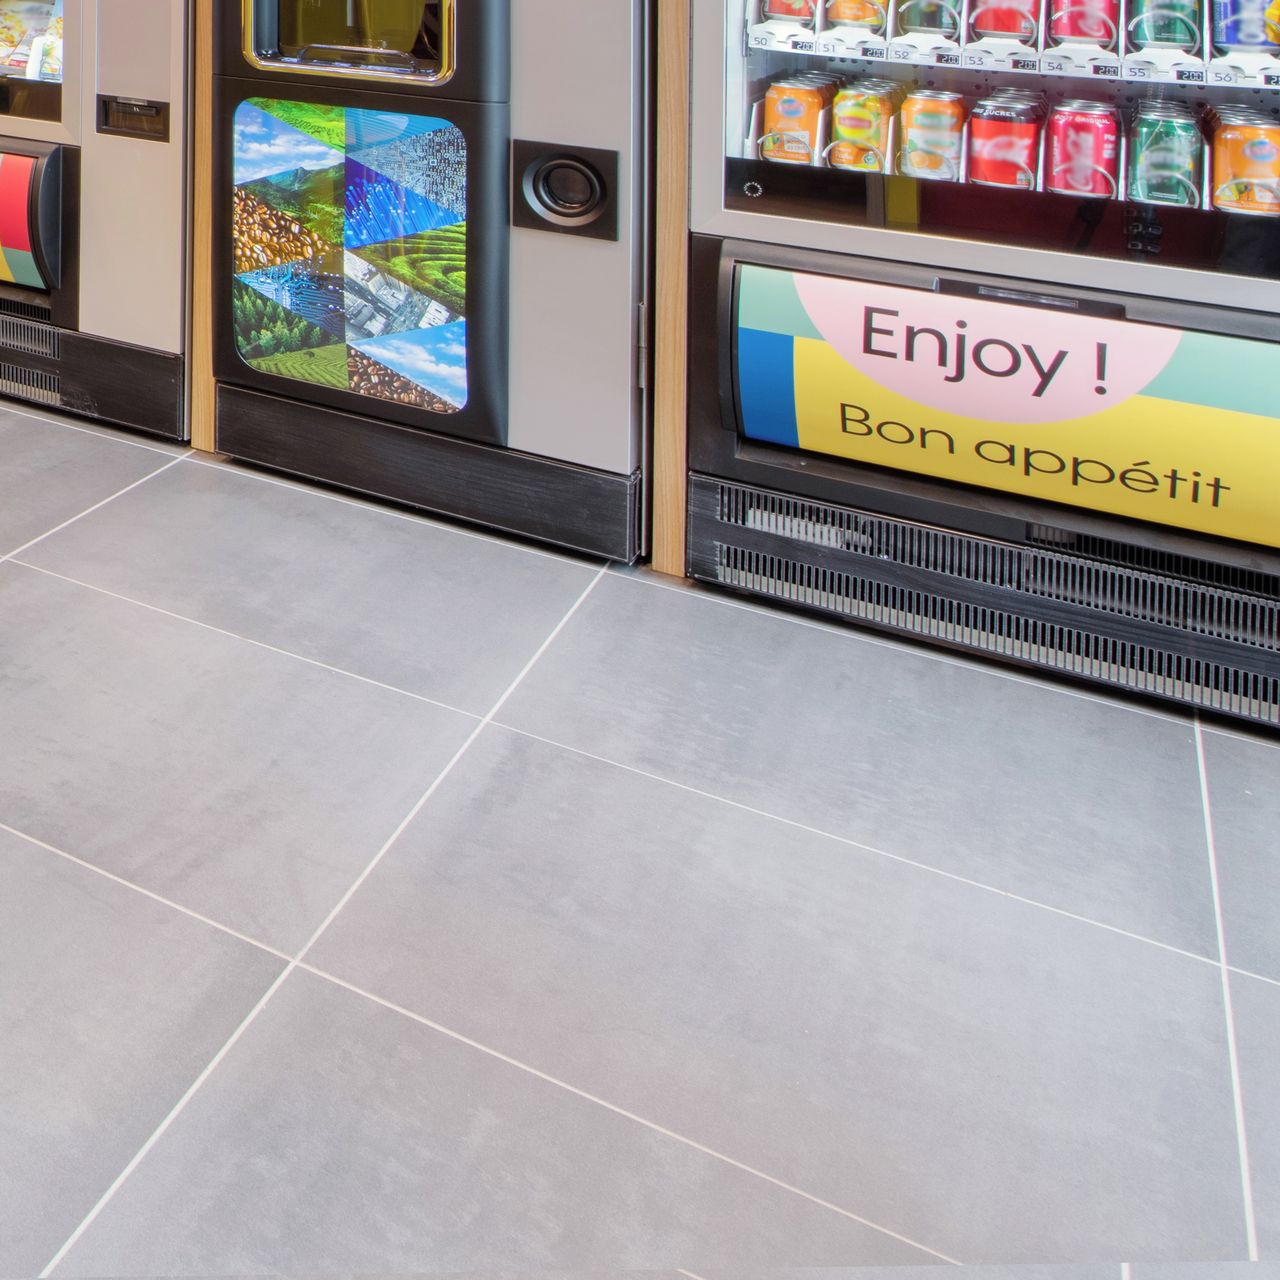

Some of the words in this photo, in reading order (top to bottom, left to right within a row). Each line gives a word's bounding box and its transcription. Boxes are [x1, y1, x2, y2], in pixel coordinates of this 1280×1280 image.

[754, 37, 767, 46] 50
[823, 44, 835, 52] 51
[895, 50, 909, 59] 52
[969, 56, 984, 65] 53
[1047, 62, 1063, 71] 54
[1129, 67, 1145, 77] 55
[1214, 73, 1232, 82] 56
[984, 109, 1017, 117] SUCRES
[862, 305, 1069, 398] Enjoy
[1093, 341, 1108, 396] !
[840, 402, 955, 455] Bon
[974, 435, 1231, 508] appétit
